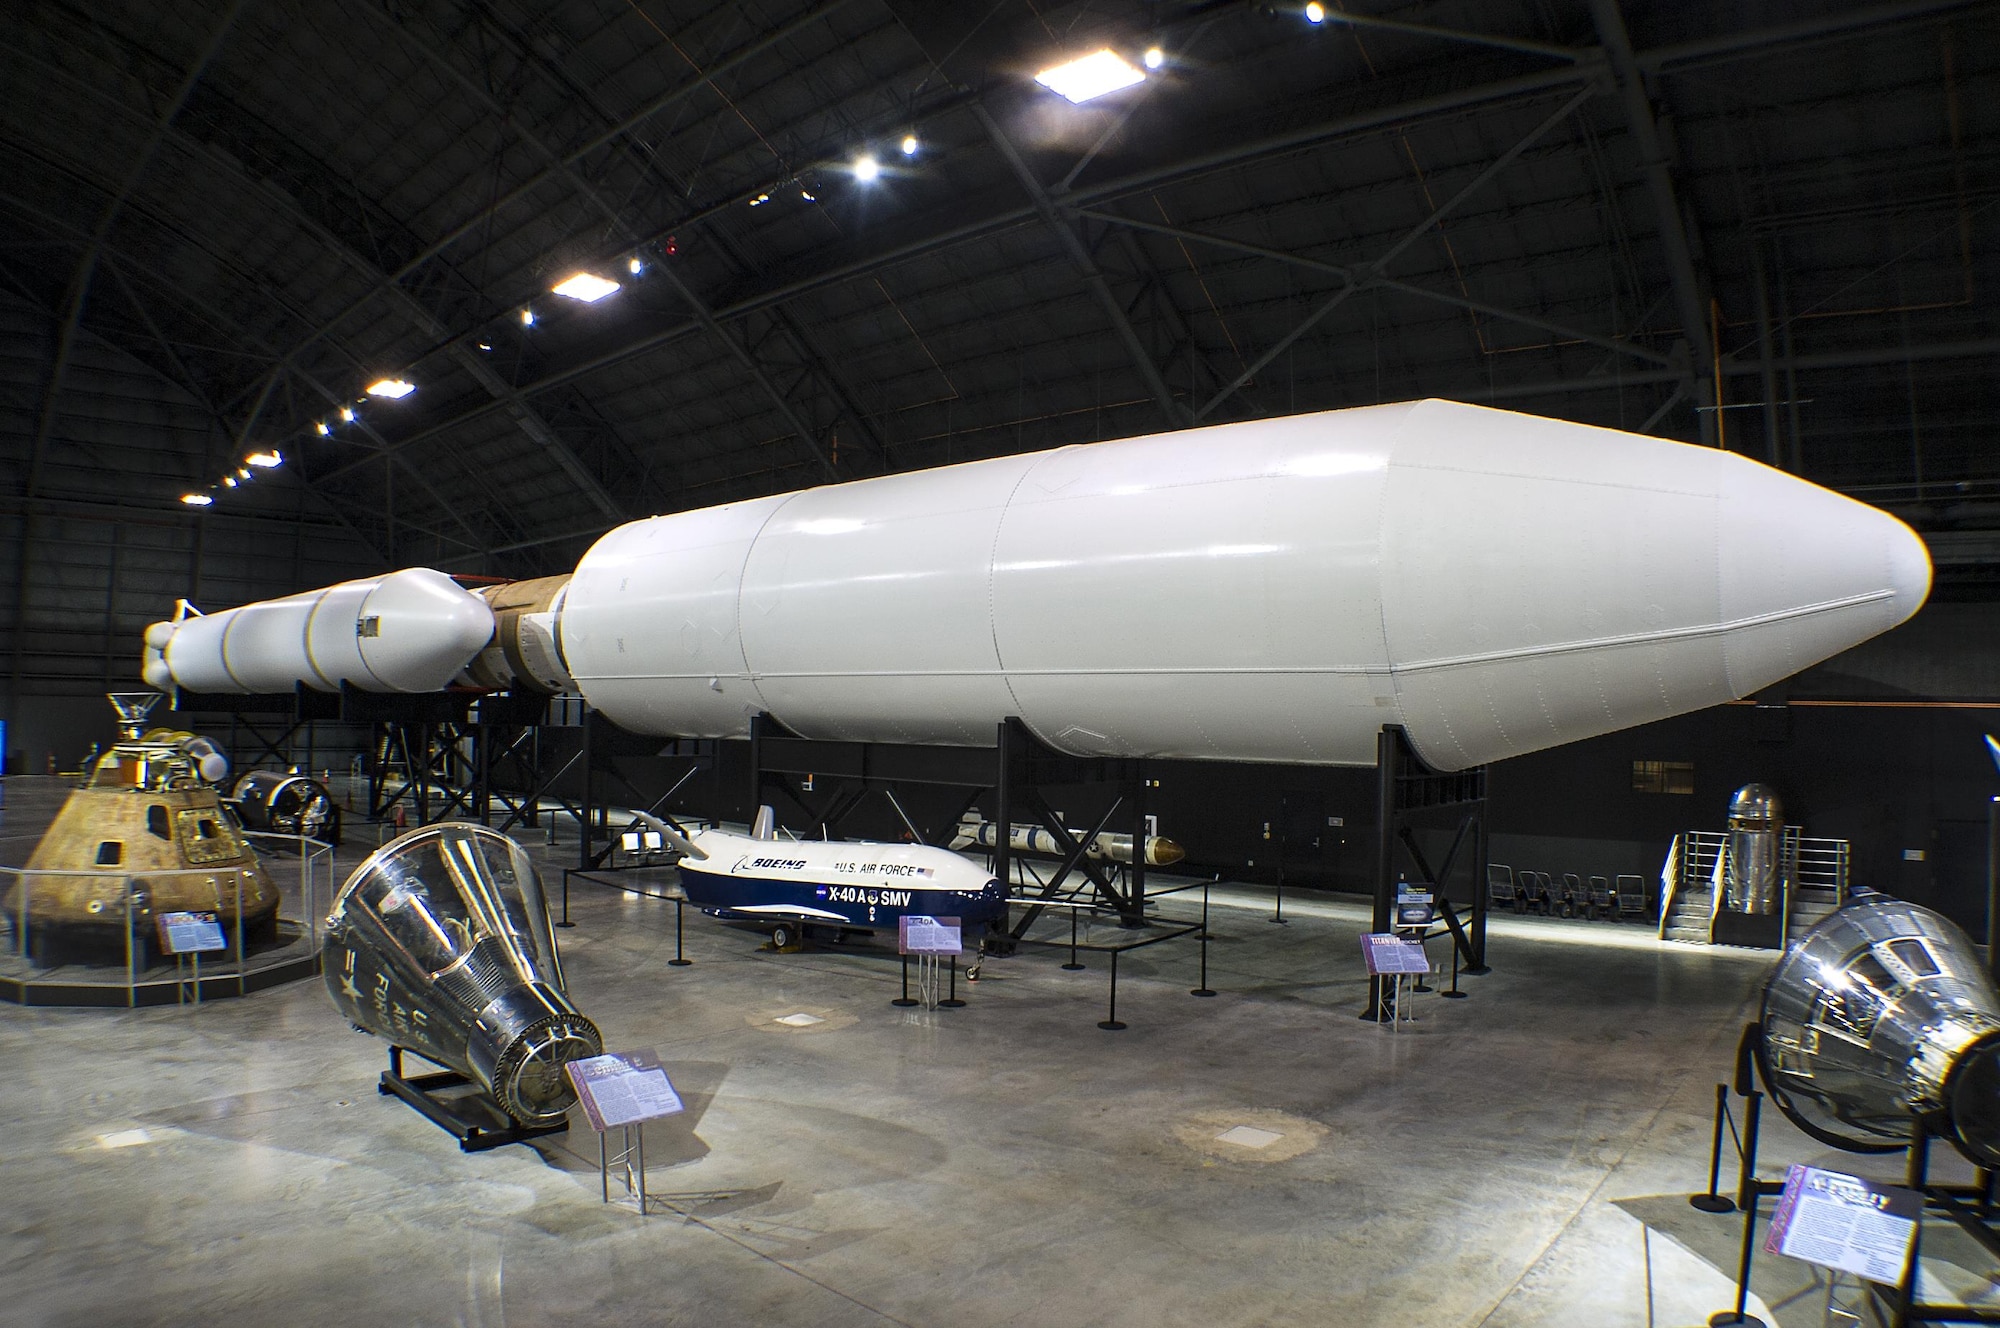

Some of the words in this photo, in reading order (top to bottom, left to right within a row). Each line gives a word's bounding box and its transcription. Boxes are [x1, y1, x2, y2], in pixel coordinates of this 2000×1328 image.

[751, 858, 807, 870] BOEING
[839, 862, 856, 873] U.S.
[859, 863, 877, 874] AIR
[879, 864, 916, 877] FORCE
[880, 890, 911, 907] SMV
